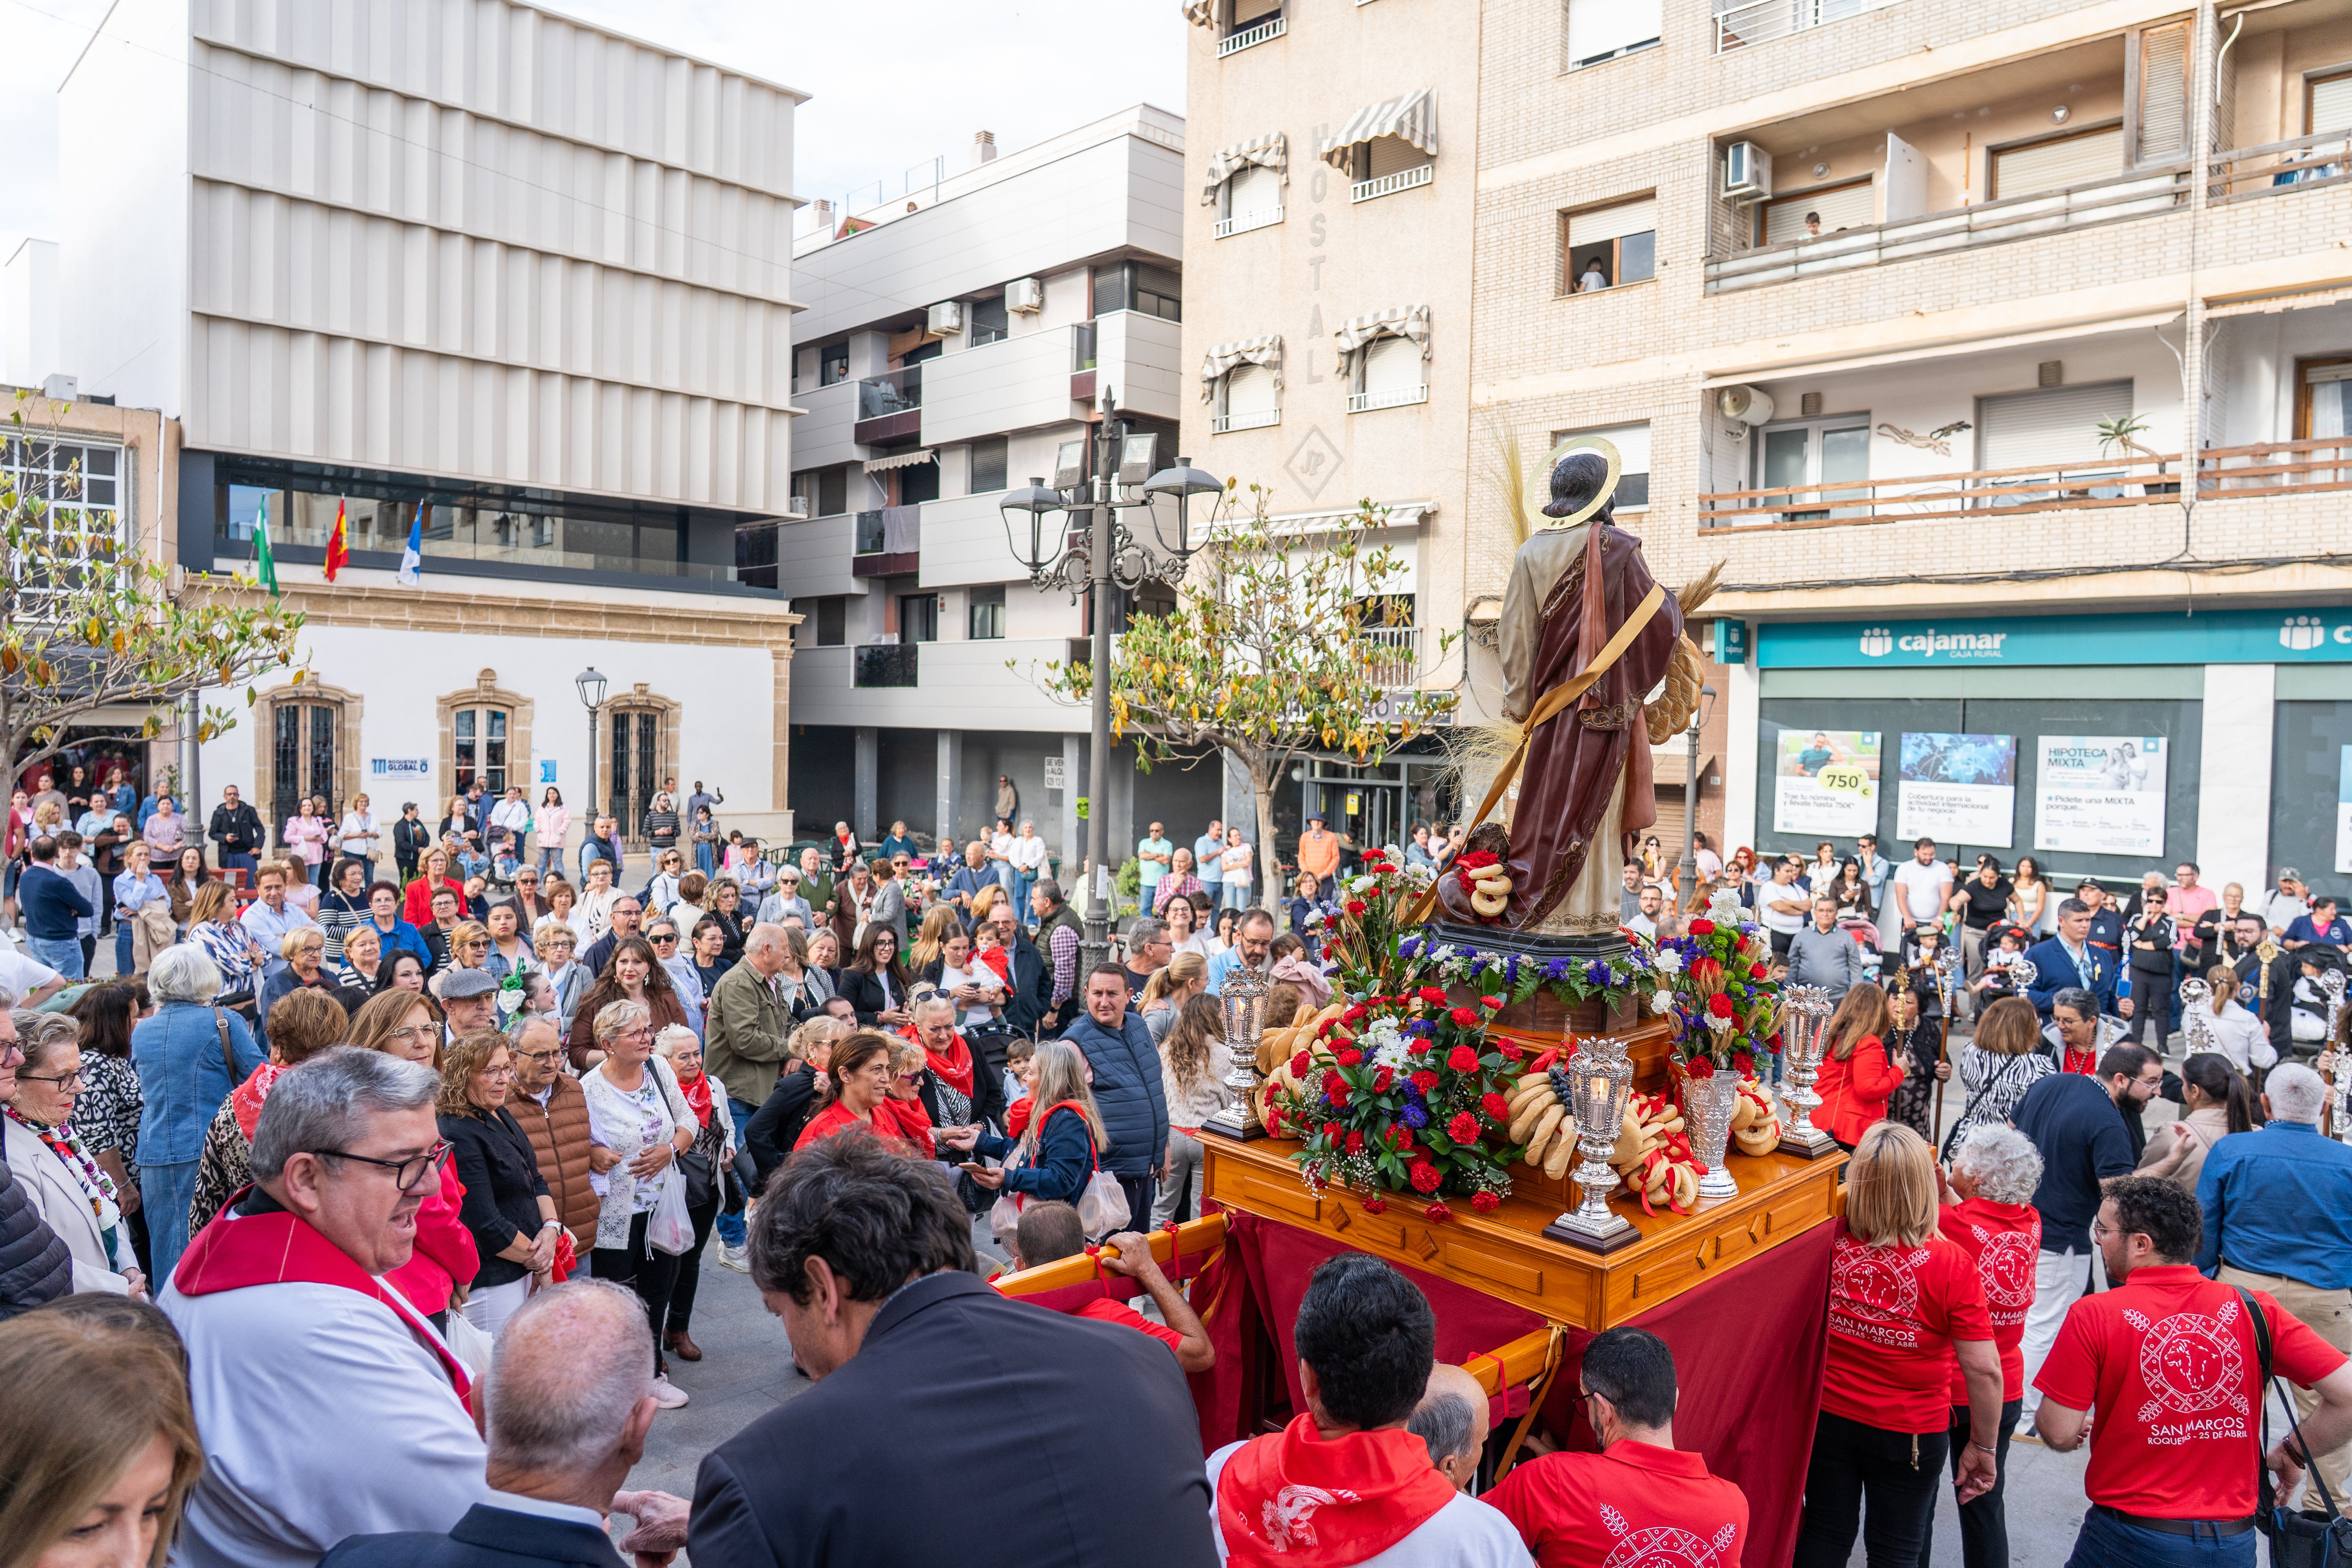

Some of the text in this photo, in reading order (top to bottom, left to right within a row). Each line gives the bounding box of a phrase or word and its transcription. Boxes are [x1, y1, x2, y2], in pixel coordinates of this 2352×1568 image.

[1307, 123, 1328, 384] HOSTAL
[2333, 624, 2352, 644] c
[1725, 644, 1744, 655] cajamar
[1898, 628, 2007, 657] cajamar
[1974, 650, 2004, 658] RURAL
[2048, 748, 2108, 758] HIPOTECA
[2048, 757, 2085, 768] MIXTA
[1907, 793, 1944, 801] Cobertura
[1946, 795, 1963, 804] para
[1942, 801, 1990, 810] internacional
[2105, 797, 2135, 805] MIXTA
[1130, 990, 1145, 1004] SO
[242, 1093, 264, 1111] Roquet
[560, 1245, 575, 1265] Roquet
[1829, 1313, 1915, 1341] SAN MARCOS
[1829, 1323, 1866, 1339] OQUETAS
[2151, 1416, 2245, 1436] SAN MARCOS
[2147, 1432, 2191, 1445] ROQUETAS
[2199, 1431, 2210, 1439] 25
[2212, 1430, 2223, 1440] DE
[2224, 1429, 2248, 1438] ABRIL
